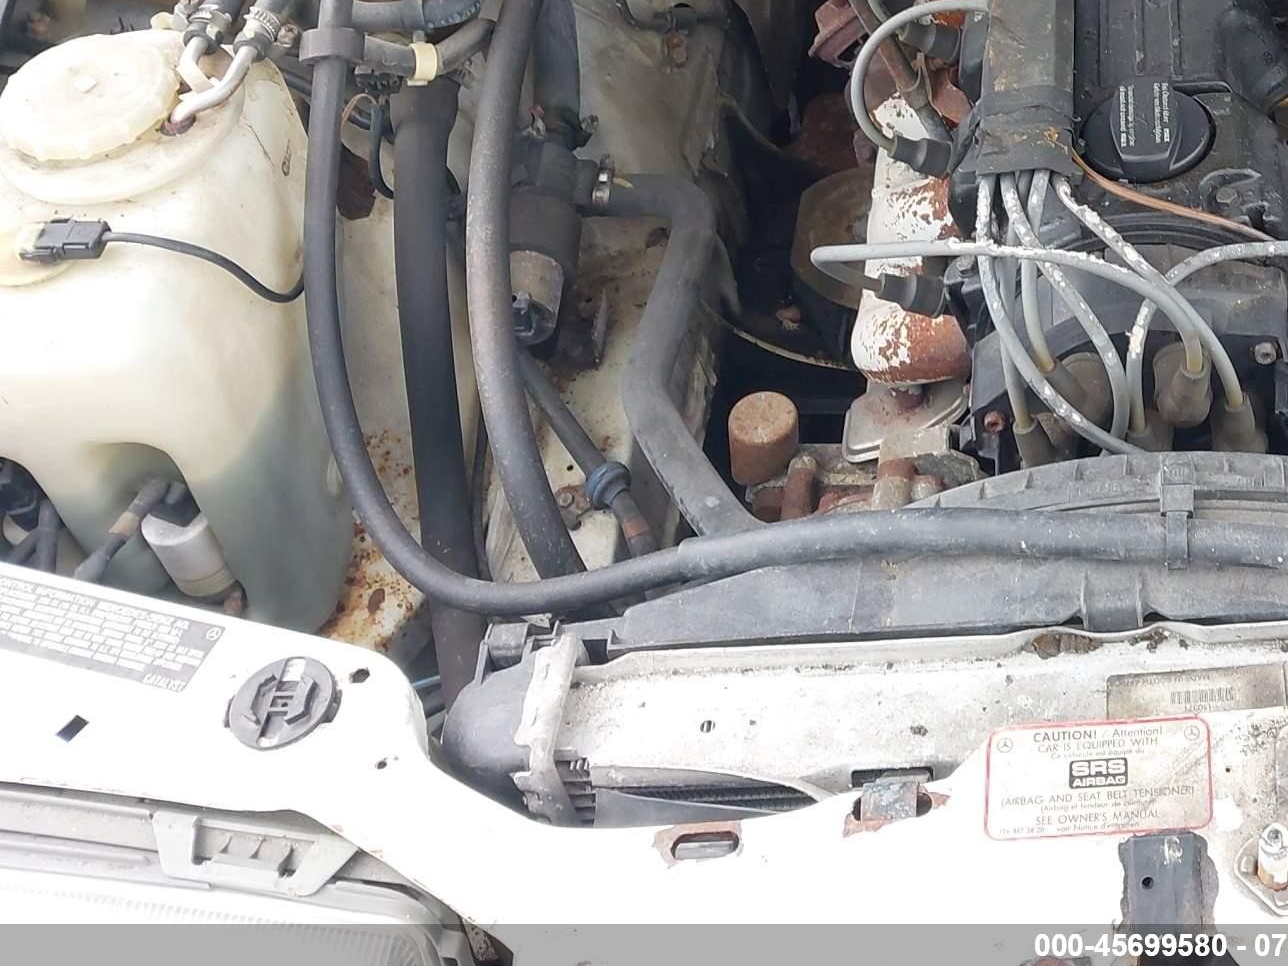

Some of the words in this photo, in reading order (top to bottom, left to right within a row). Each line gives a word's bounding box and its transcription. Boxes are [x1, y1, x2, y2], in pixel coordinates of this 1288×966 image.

[142, 672, 187, 693] CATALYST
[1033, 730, 1097, 743] CAUTION!
[1112, 726, 1163, 738] Attention!
[1038, 742, 1059, 753] CAR
[1063, 742, 1072, 752] IS
[1076, 737, 1126, 751] EQUIPPED
[1130, 736, 1158, 747] WITH
[1071, 759, 1126, 777] SRS
[1072, 775, 1126, 788] AIRBAG
[1048, 793, 1073, 803] AND
[1077, 791, 1101, 802] SEAT
[1106, 789, 1127, 801] BELT
[1036, 815, 1053, 826] SEE
[1057, 812, 1108, 825] OWNER'S
[1112, 809, 1159, 822] MANUAL
